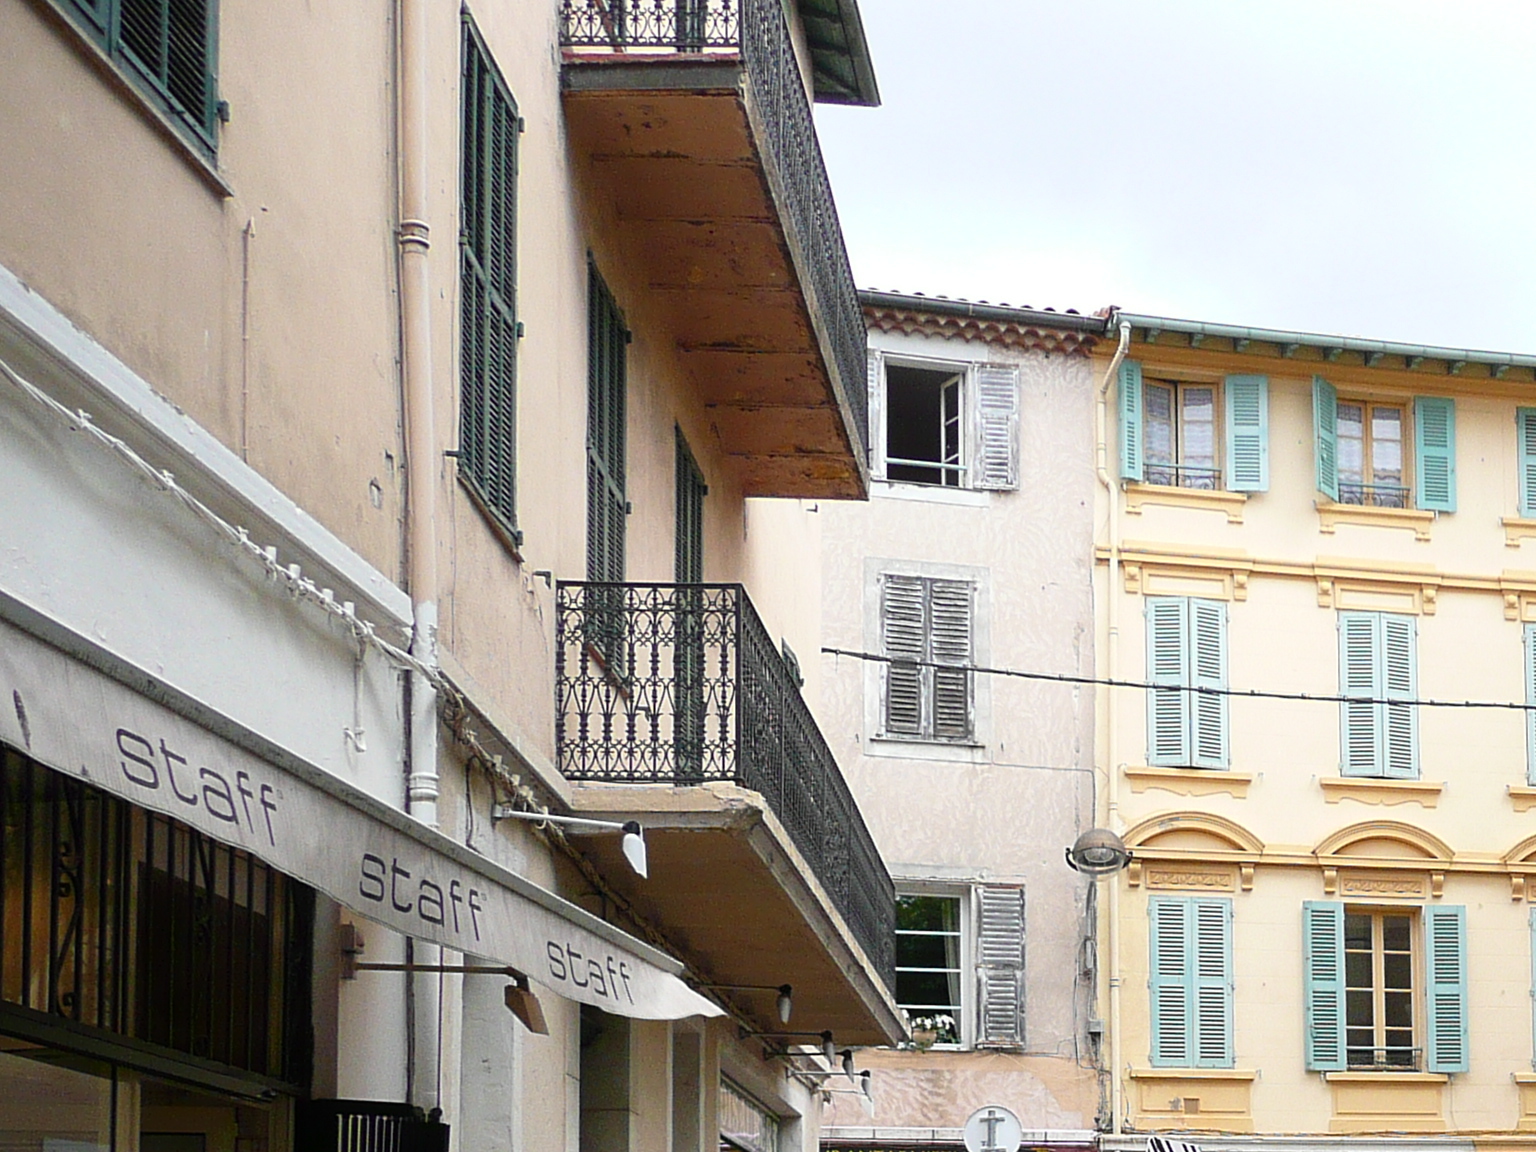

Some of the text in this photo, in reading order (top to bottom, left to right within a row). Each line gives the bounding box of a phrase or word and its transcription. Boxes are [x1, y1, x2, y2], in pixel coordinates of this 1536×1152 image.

[116, 728, 277, 847] staff
[359, 853, 483, 942] staff
[547, 941, 634, 1005] staff
